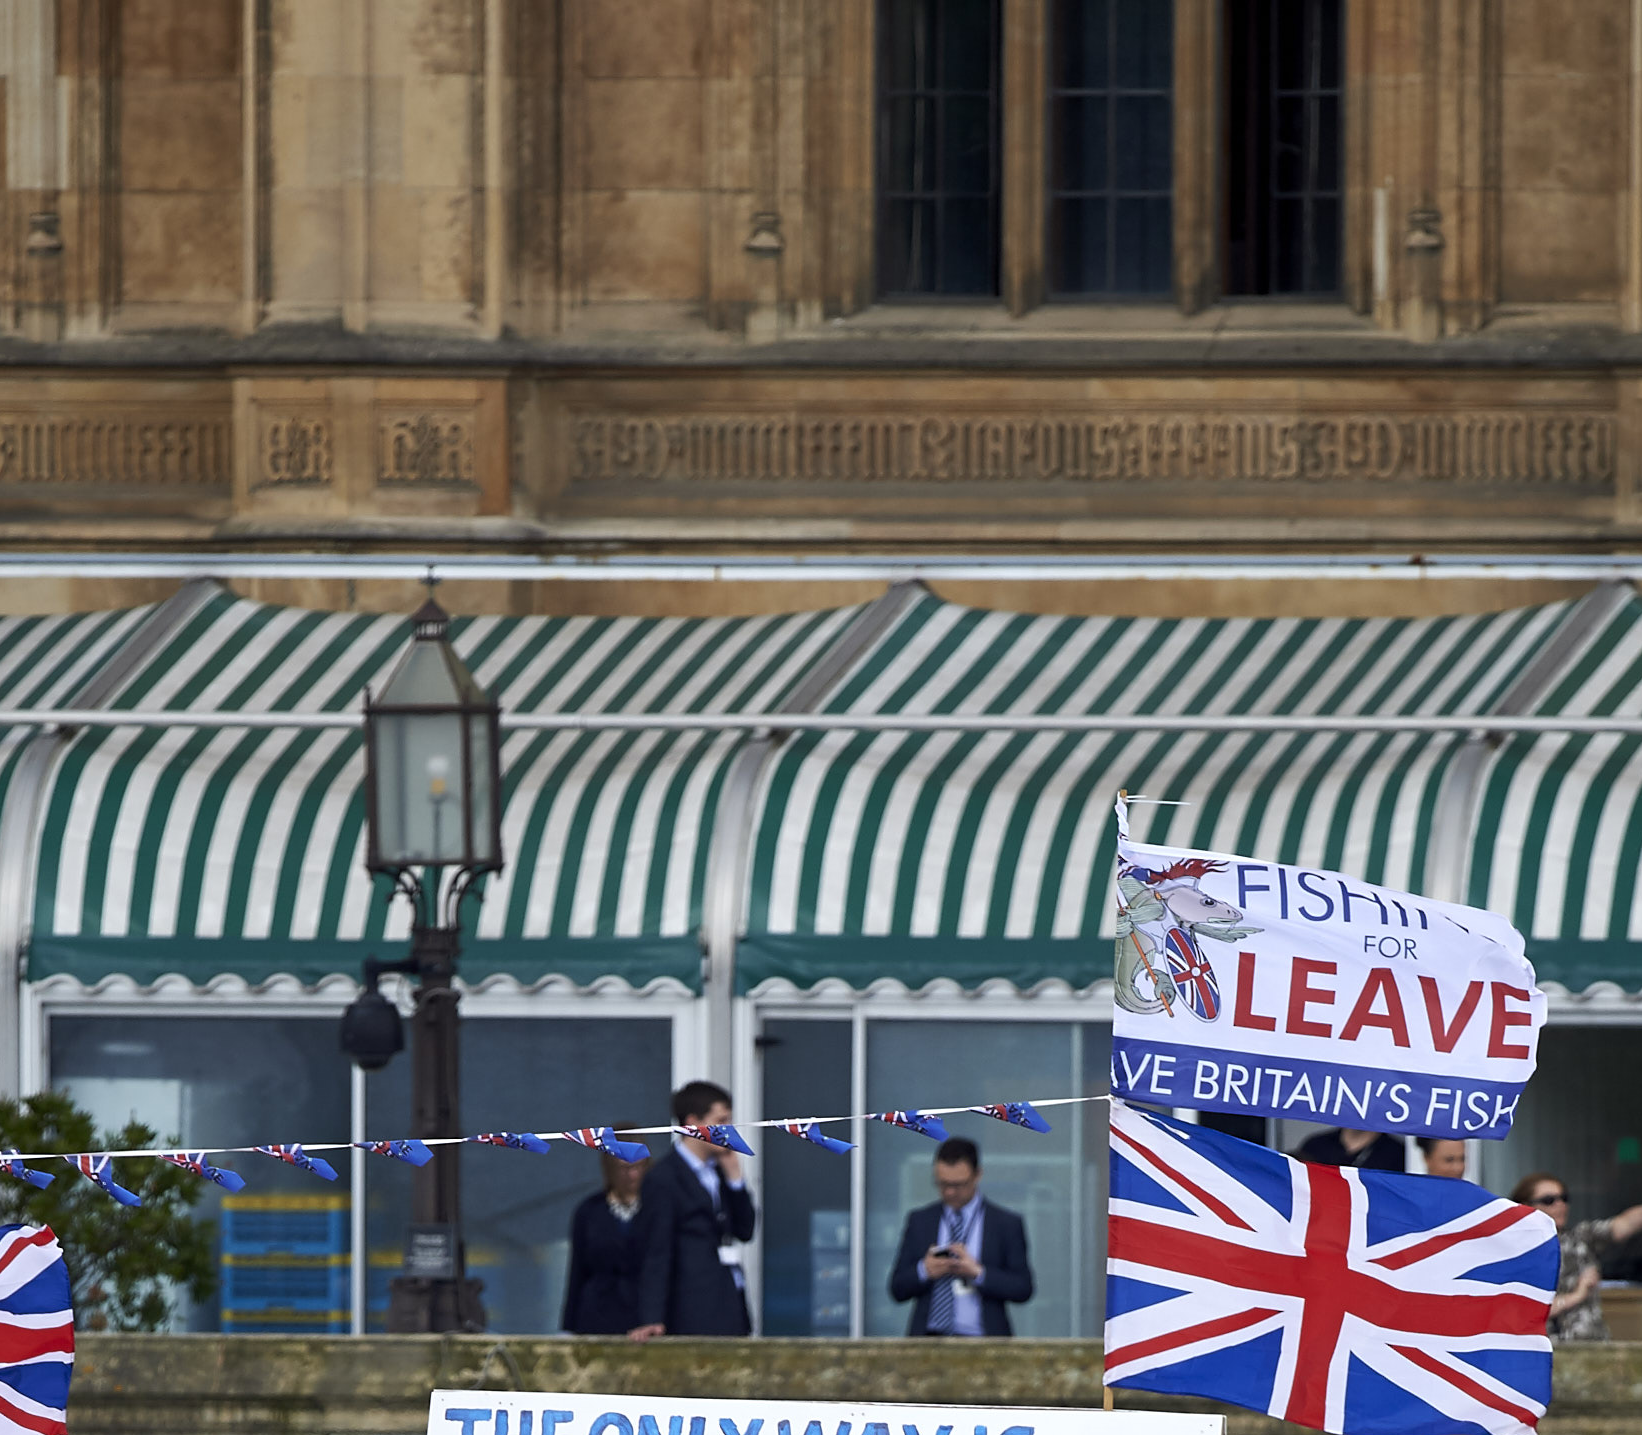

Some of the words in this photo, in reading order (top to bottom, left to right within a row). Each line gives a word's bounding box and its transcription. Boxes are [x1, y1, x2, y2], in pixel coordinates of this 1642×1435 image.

[1363, 935, 1418, 960] FOR
[1233, 951, 1532, 1061] LEAVE
[1194, 1060, 1412, 1123] BRITAIN'S
[1425, 1086, 1521, 1131] FISH
